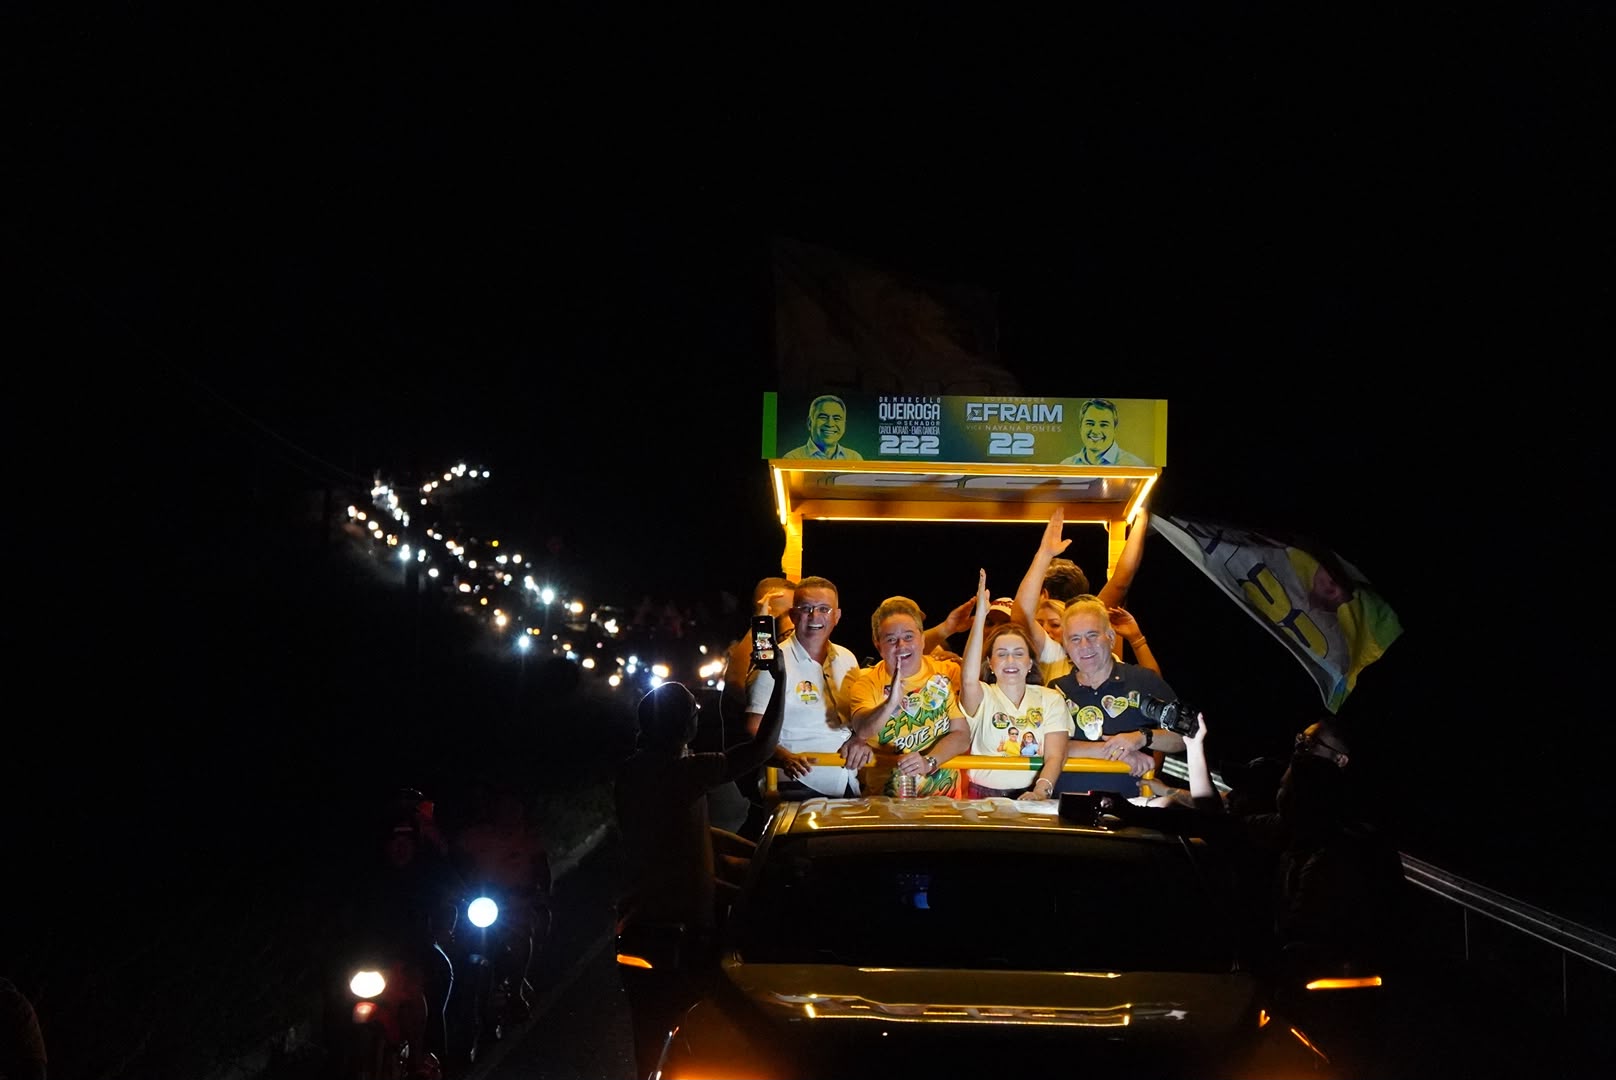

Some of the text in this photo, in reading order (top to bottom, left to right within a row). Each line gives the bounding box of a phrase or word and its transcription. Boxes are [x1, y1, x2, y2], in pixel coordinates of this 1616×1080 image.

[879, 403, 940, 421] QUEIROGA
[966, 403, 1063, 422] EFRAIM
[1026, 425, 1063, 433] PONTES
[880, 435, 940, 454] 222
[989, 432, 1035, 455] 22
[895, 726, 930, 751] BOTE
